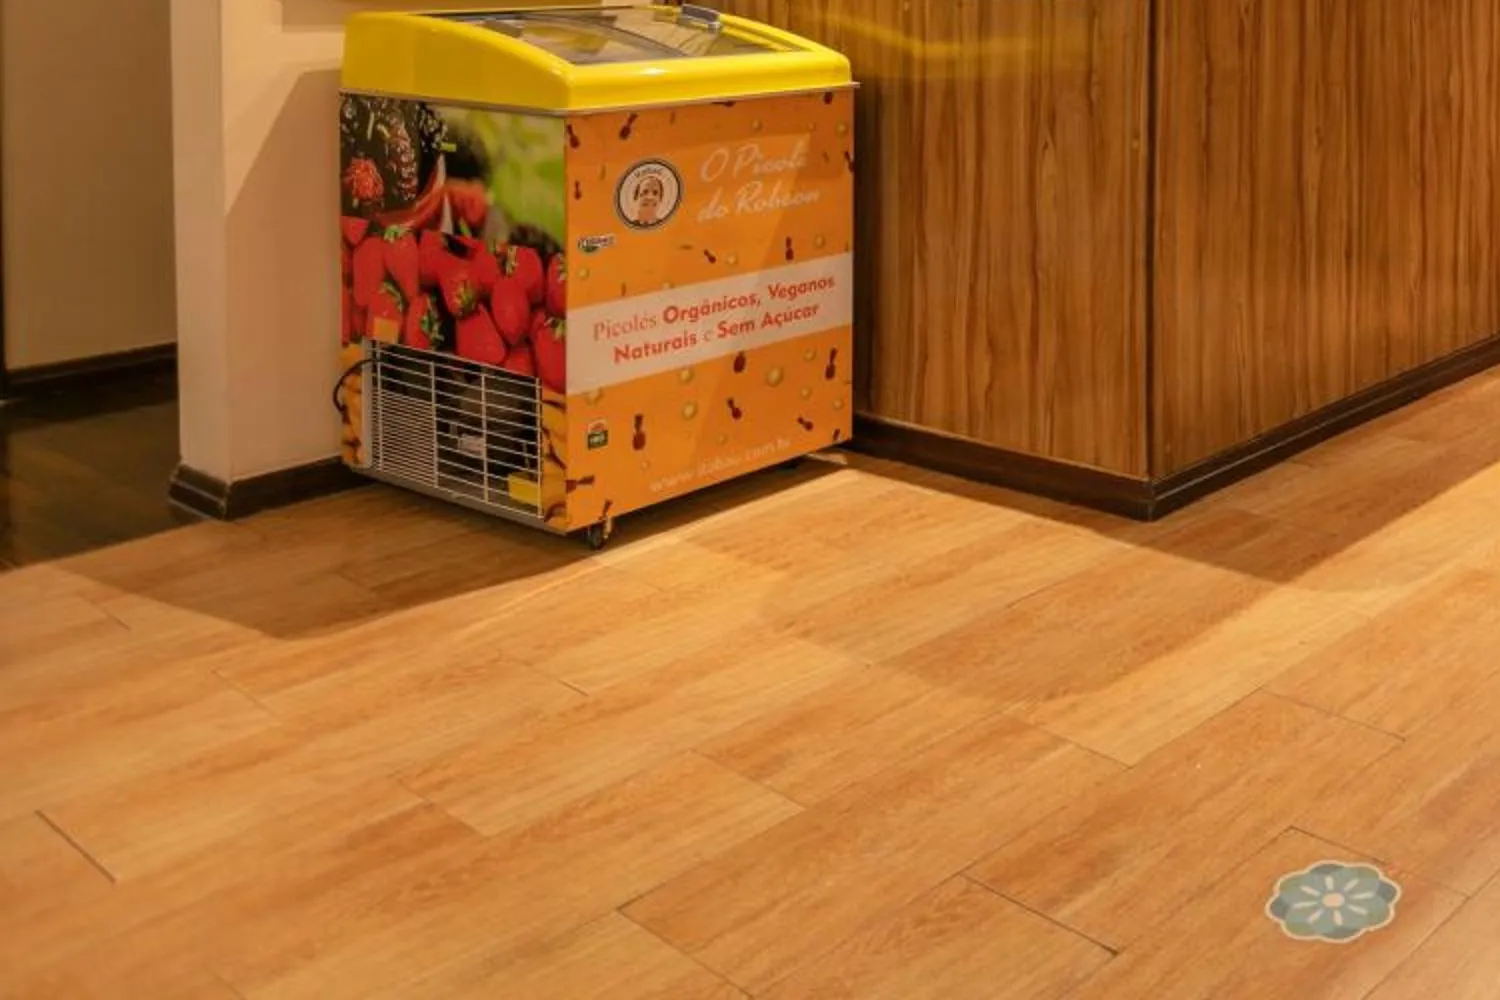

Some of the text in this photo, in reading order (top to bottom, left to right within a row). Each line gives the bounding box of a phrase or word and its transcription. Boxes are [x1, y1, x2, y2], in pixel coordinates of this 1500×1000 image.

[702, 147, 729, 181] O
[592, 275, 836, 342] Picolés Orgânicos, Veganos
[613, 303, 821, 364] Naturais e Sem Açúcar
